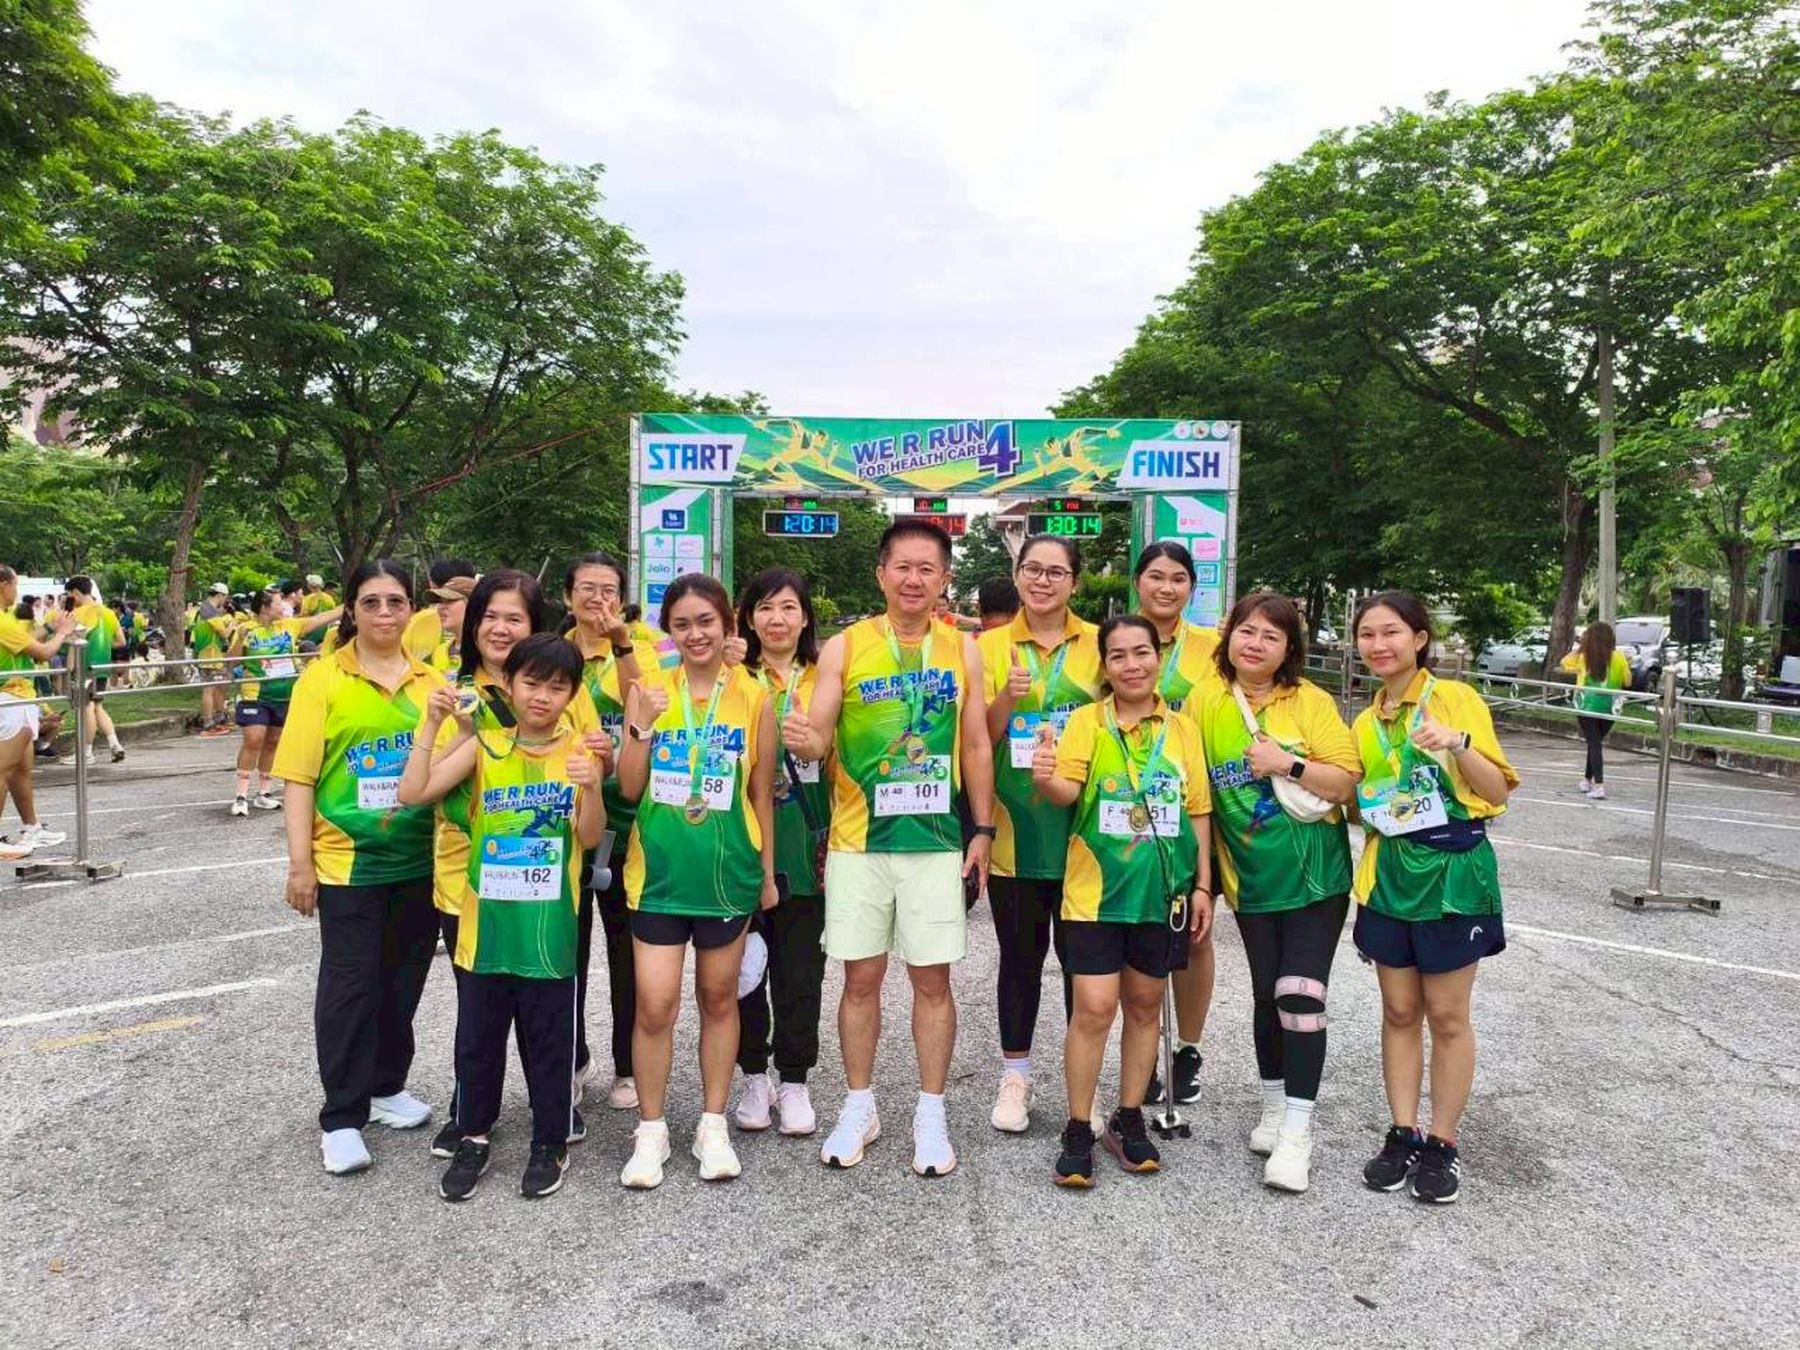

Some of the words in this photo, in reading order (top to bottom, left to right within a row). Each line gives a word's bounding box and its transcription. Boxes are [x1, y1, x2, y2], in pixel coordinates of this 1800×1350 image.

[649, 443, 733, 471] START
[852, 437, 895, 464] WE
[903, 433, 920, 454] R
[929, 420, 984, 449] RUN
[978, 422, 1018, 474] 4
[859, 463, 886, 478] FOR
[891, 452, 943, 472] HEALTH
[949, 444, 986, 460] CARE
[1132, 451, 1220, 478] FINISH
[859, 677, 885, 694] WE
[890, 675, 902, 688] R
[937, 671, 957, 701] 4
[377, 738, 388, 751] R
[677, 729, 687, 740] R
[724, 728, 744, 751] 4
[704, 778, 723, 793] 58
[880, 788, 889, 797] M
[914, 784, 940, 798] 101
[507, 785, 519, 799] R
[525, 781, 560, 797] RUN
[554, 785, 573, 817] 4
[1414, 796, 1432, 814] 20
[1108, 806, 1114, 816] F
[1151, 805, 1167, 820] 51
[521, 867, 551, 883] 162
